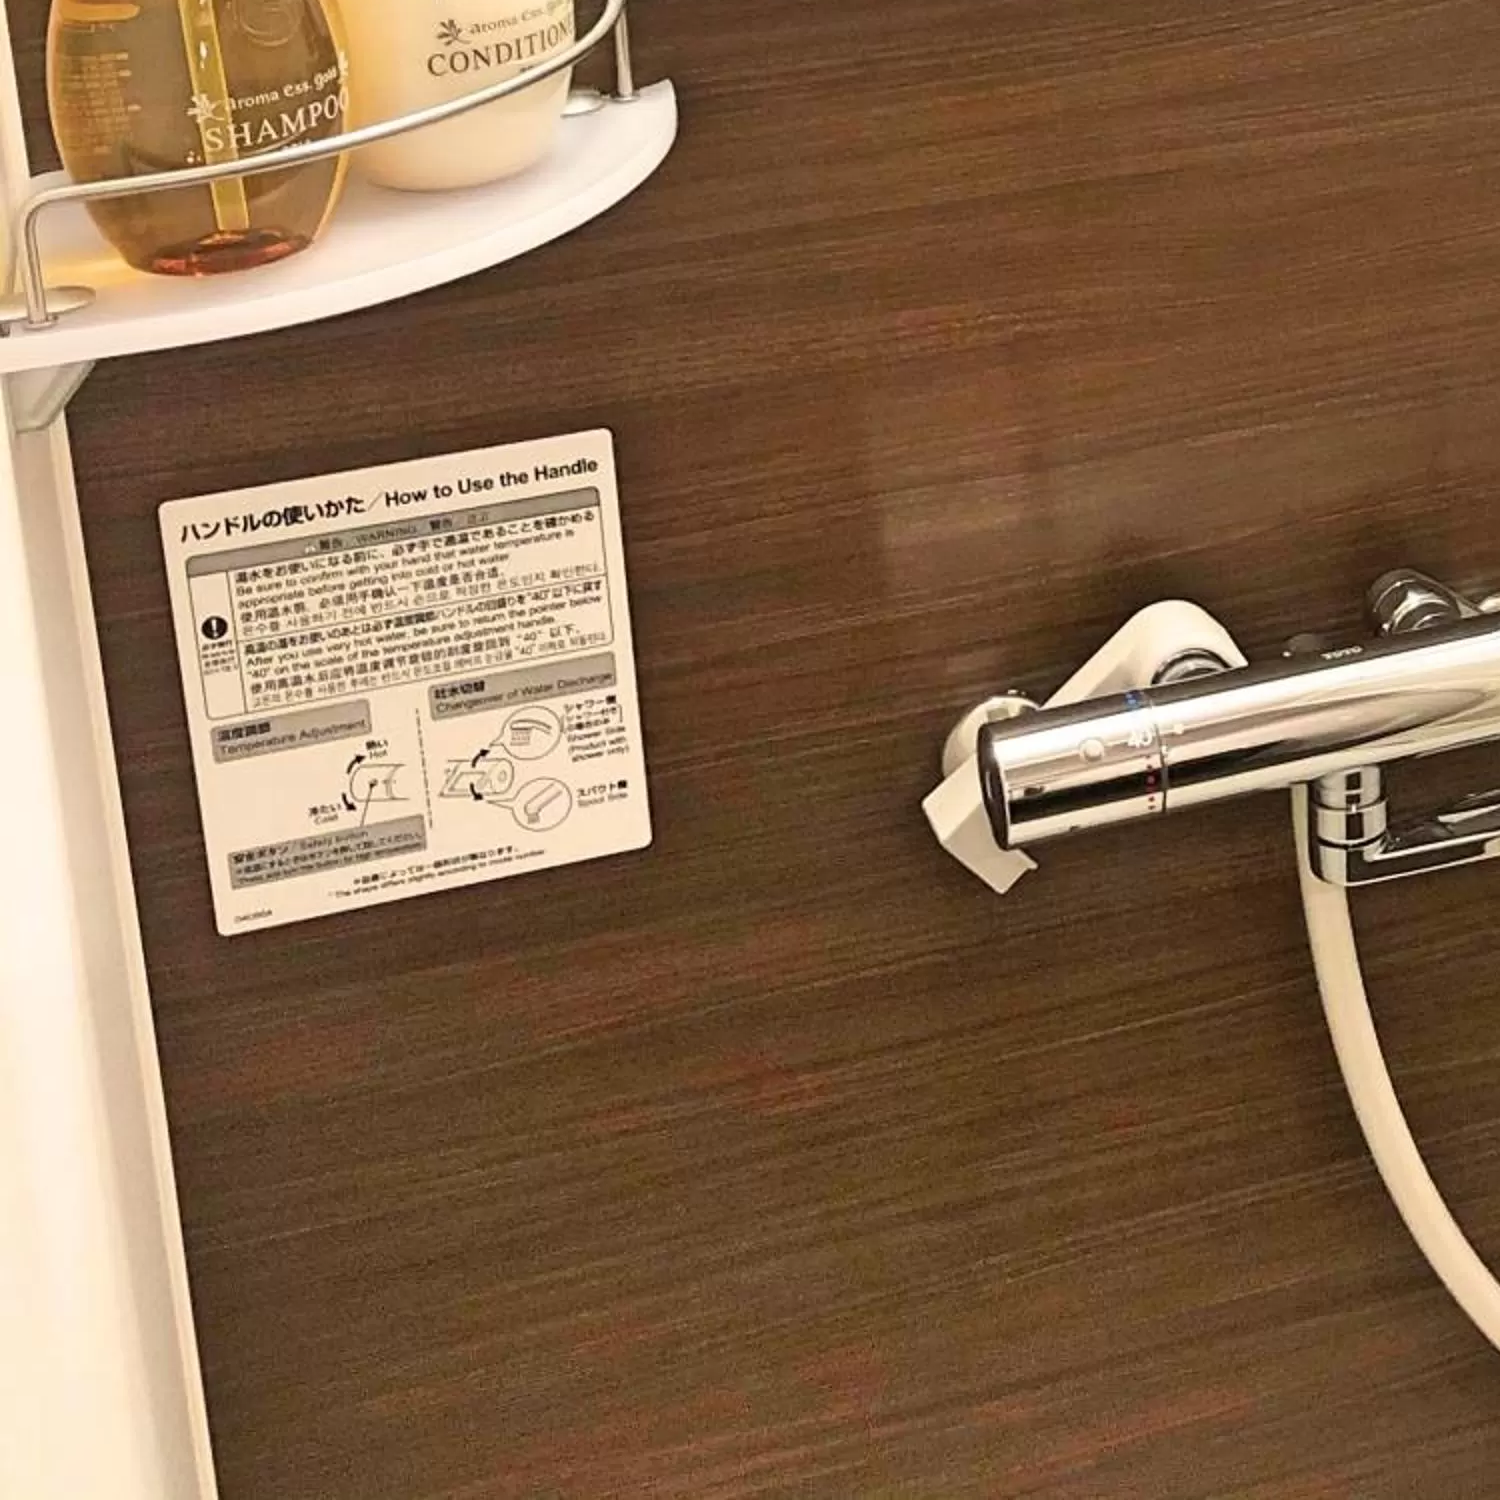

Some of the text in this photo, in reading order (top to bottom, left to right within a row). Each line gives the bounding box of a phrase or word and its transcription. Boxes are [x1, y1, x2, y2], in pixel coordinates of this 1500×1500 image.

[384, 485, 427, 508] How
[432, 480, 452, 500] to
[457, 473, 494, 495] Use
[499, 467, 529, 488] the
[533, 455, 598, 482] Handle
[236, 584, 252, 596] Be
[255, 579, 282, 593] sure
[285, 576, 297, 588] to
[299, 568, 343, 585] confirm
[346, 563, 370, 577] with
[373, 558, 399, 574] your
[401, 552, 431, 567] hand
[433, 548, 456, 561] that
[458, 542, 490, 556] water
[493, 529, 562, 552] temperature
[237, 588, 305, 611] appropriate
[307, 581, 345, 596] before
[348, 573, 389, 590] getting
[390, 568, 412, 581] into
[415, 564, 439, 576] cold
[441, 561, 453, 572] or
[457, 557, 475, 569] hot
[245, 654, 273, 667] After
[277, 649, 298, 663] you
[301, 645, 323, 657] use
[326, 639, 352, 654] very
[353, 635, 372, 647] hot
[412, 625, 428, 636] be
[430, 620, 456, 633] sure
[458, 617, 470, 628] to
[471, 611, 506, 625] return
[507, 607, 526, 618] the
[528, 599, 566, 617] pointer
[569, 593, 601, 607] below
[273, 663, 289, 674] on
[291, 659, 310, 671] the
[313, 653, 344, 667] scale
[346, 650, 359, 660] of
[360, 646, 379, 658] the
[381, 633, 451, 656] temperature
[452, 621, 514, 643] adjustment
[435, 669, 612, 715] Changeover of Water Discharge
[219, 717, 367, 757] Temperature Adjustment
[369, 748, 388, 759] Hot
